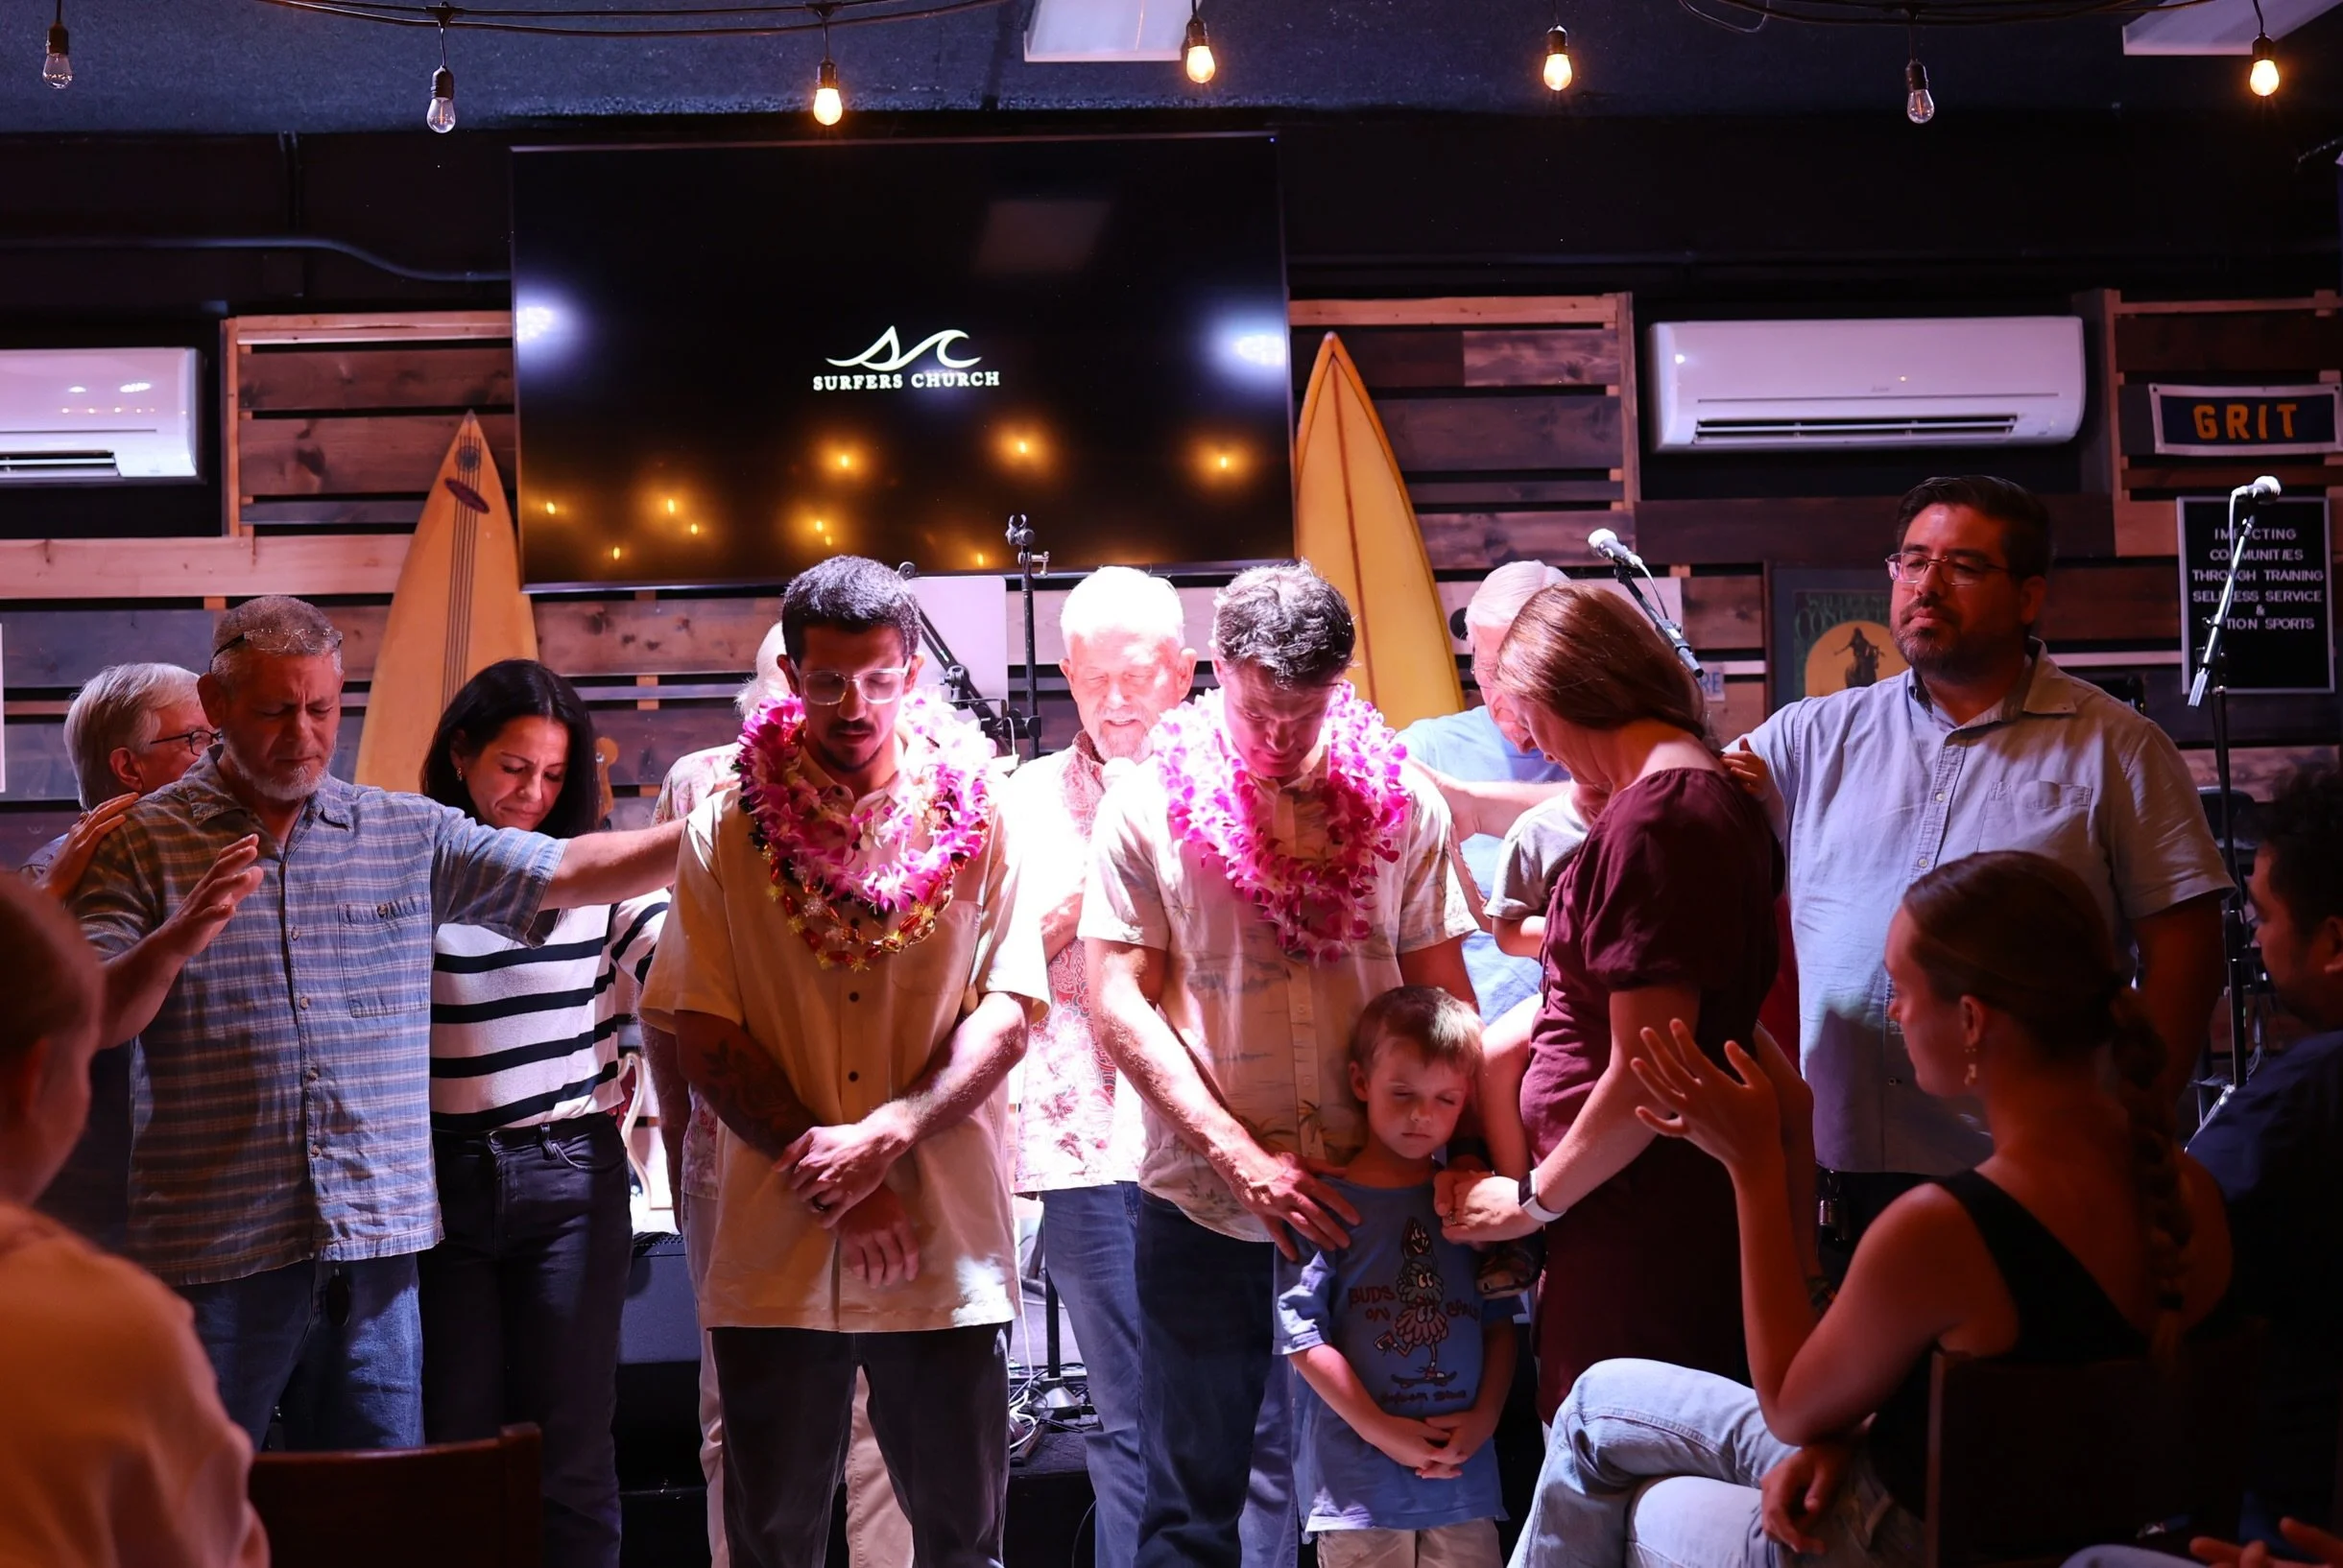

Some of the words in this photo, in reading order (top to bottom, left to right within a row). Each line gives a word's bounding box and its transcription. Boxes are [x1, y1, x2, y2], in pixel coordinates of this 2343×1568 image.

[813, 373, 903, 391] SURFERS
[911, 370, 1000, 389] CHURCH
[2193, 403, 2297, 440] GRIT
[2210, 549, 2304, 561] COMUNITIES
[2191, 569, 2256, 582] THROGH
[2263, 569, 2324, 582] TRAINING
[2265, 590, 2322, 603] SERVICE
[2256, 604, 2265, 616] &
[2264, 617, 2315, 630] SPORTS
